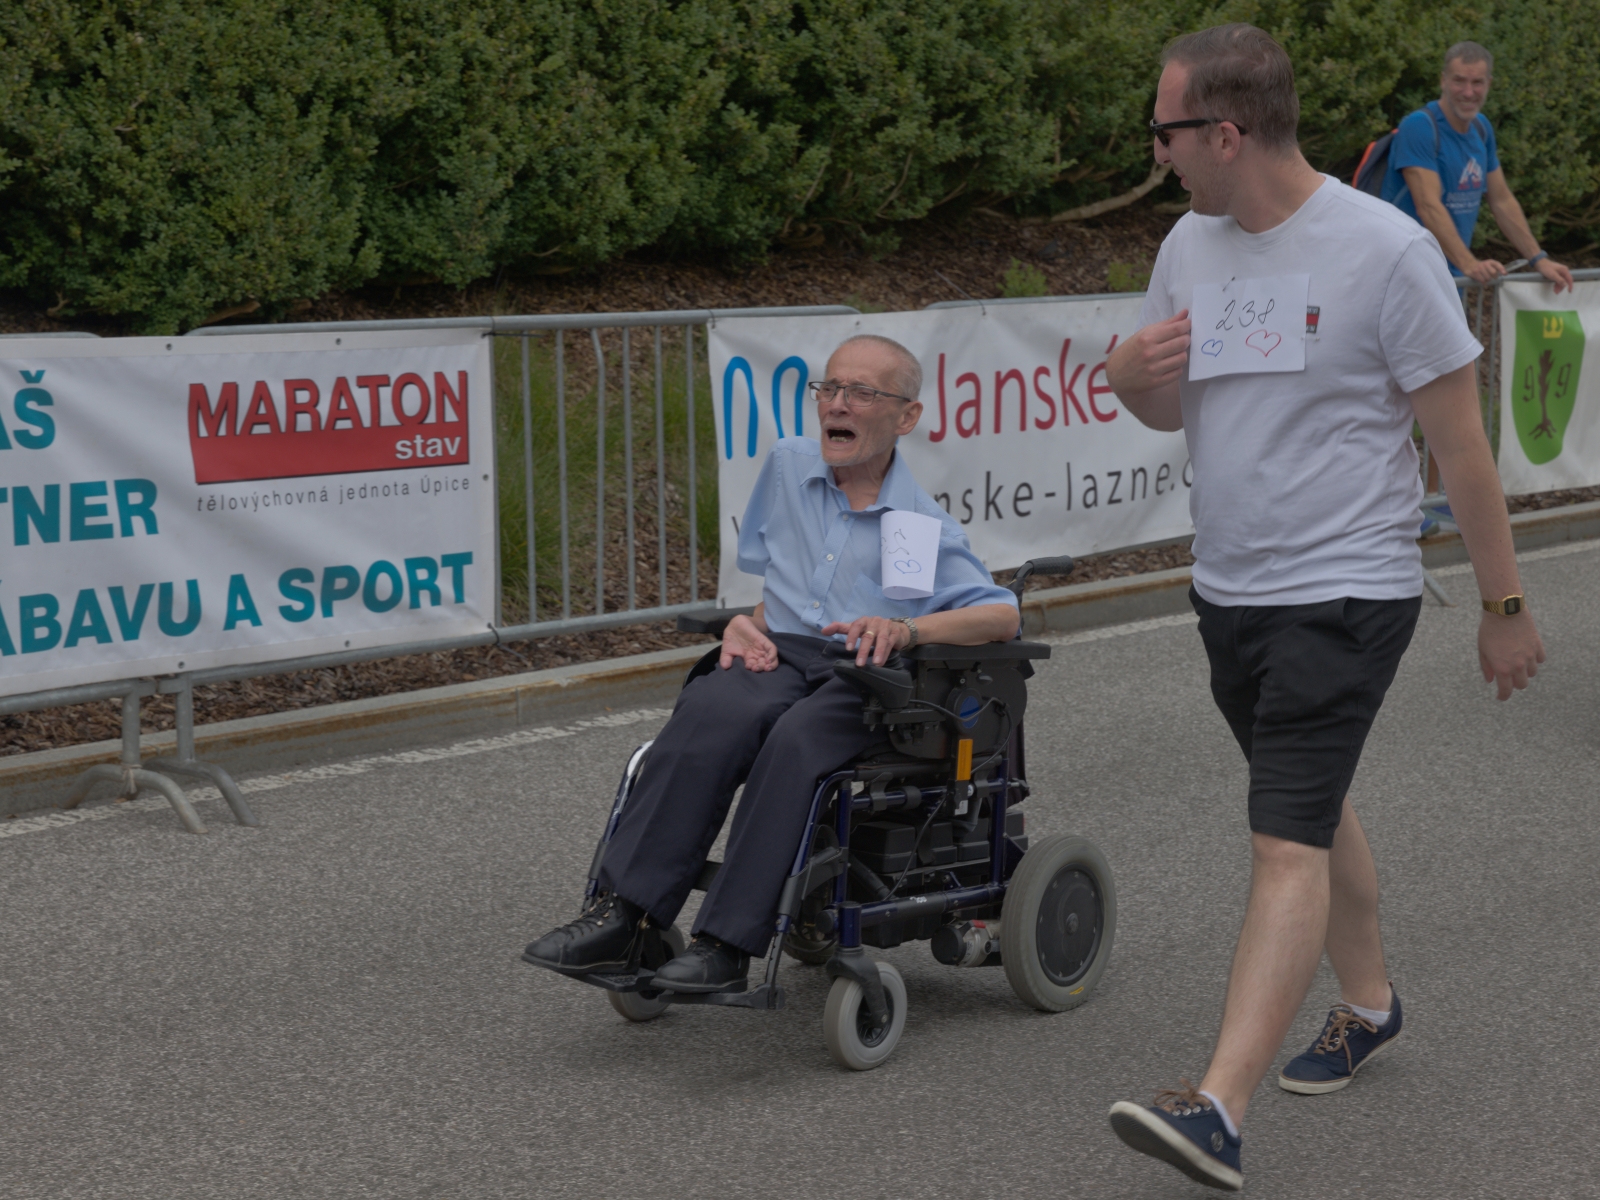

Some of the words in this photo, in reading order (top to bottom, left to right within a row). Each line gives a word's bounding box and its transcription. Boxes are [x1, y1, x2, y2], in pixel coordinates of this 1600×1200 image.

[1215, 298, 1275, 332] 238
[188, 371, 469, 438] MARATON
[928, 334, 1119, 443] Janské
[395, 434, 461, 460] stav
[0, 478, 159, 547] NER
[197, 486, 329, 512] tělovýchovná
[339, 481, 410, 504] jednota
[420, 474, 470, 496] Úpice
[223, 573, 263, 631] A
[277, 551, 474, 623] SPORT
